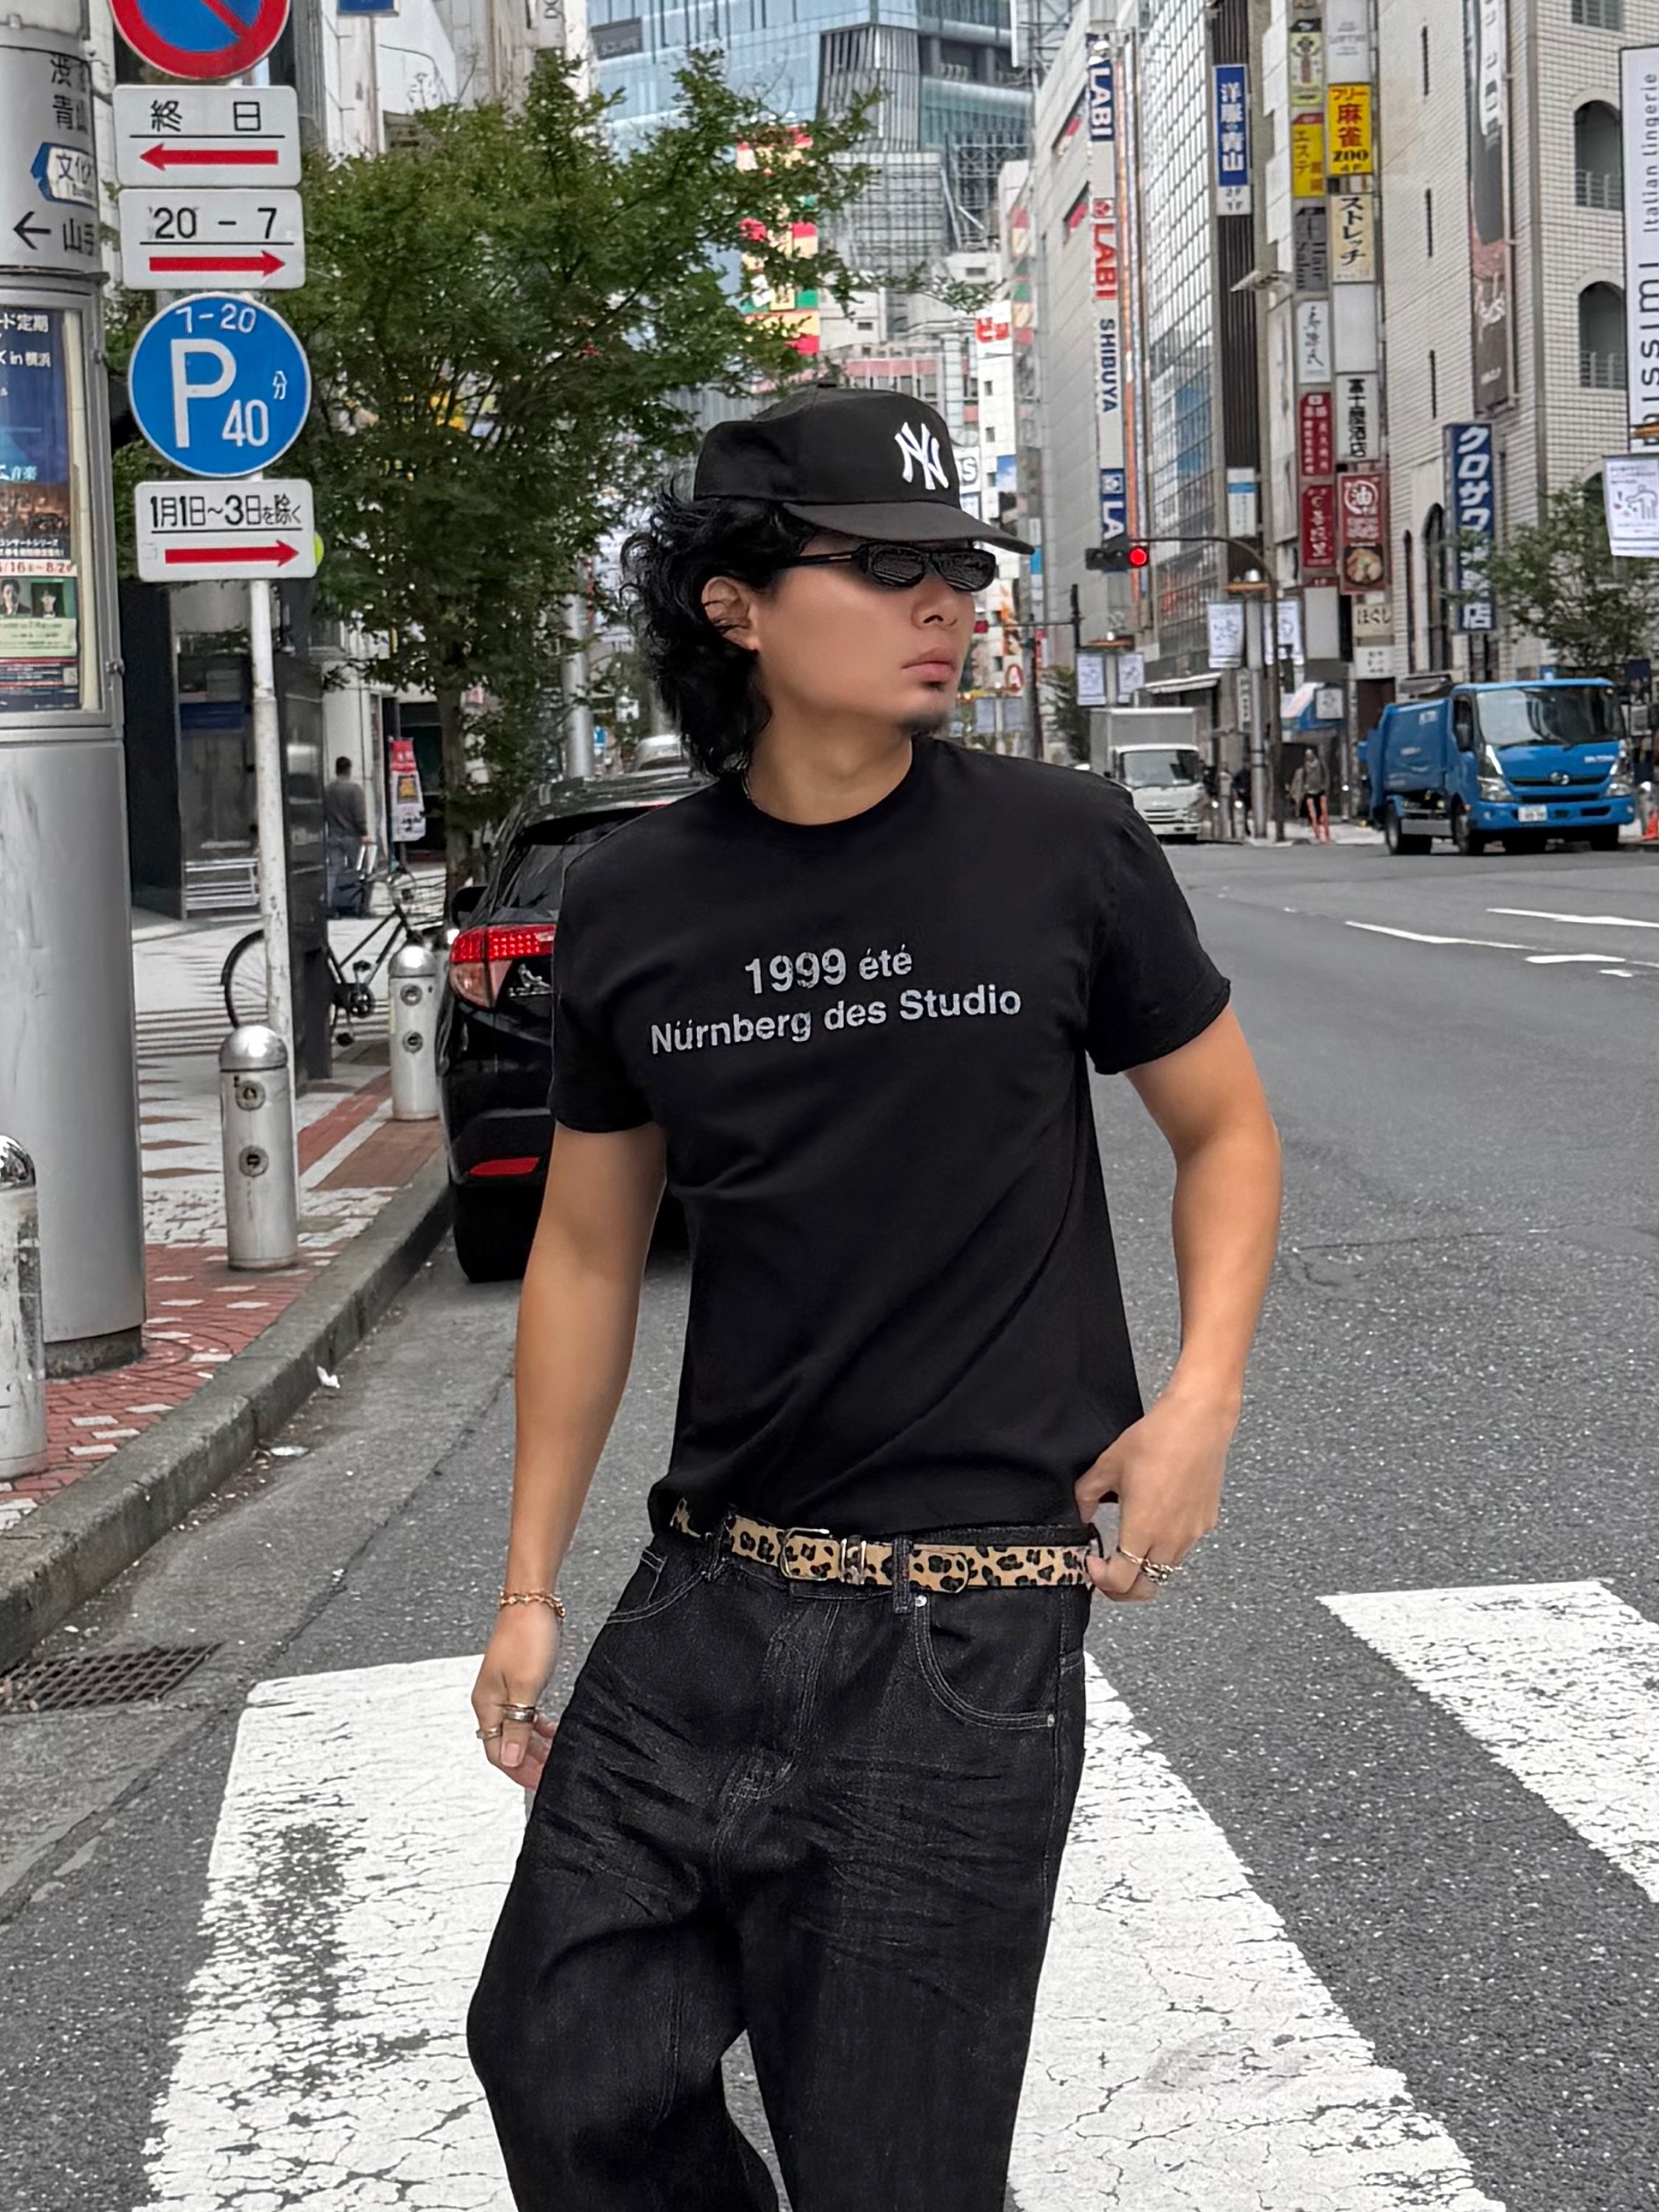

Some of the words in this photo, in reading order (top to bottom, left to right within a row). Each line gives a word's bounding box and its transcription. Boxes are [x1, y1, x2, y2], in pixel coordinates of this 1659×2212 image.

[1089, 67, 1113, 136] LABI
[1331, 88, 1367, 101] フリー
[1640, 73, 1659, 156] lingerie
[1337, 103, 1364, 147] 麻雀
[1332, 149, 1369, 162] ZOO
[152, 207, 197, 239] 20
[257, 208, 277, 239] 7
[1641, 165, 1659, 232] Italian
[1340, 196, 1366, 266] ストレッチ
[1094, 224, 1117, 300] LABI
[176, 303, 257, 333] 7-20
[1100, 318, 1117, 413] SHIBUYA
[171, 338, 237, 448] P
[222, 399, 269, 447] 40
[895, 422, 949, 491] NY
[1103, 500, 1124, 540] LA
[745, 948, 847, 995] 1999
[859, 944, 913, 981] été
[824, 1000, 888, 1032] des
[899, 983, 1022, 1021] Studio
